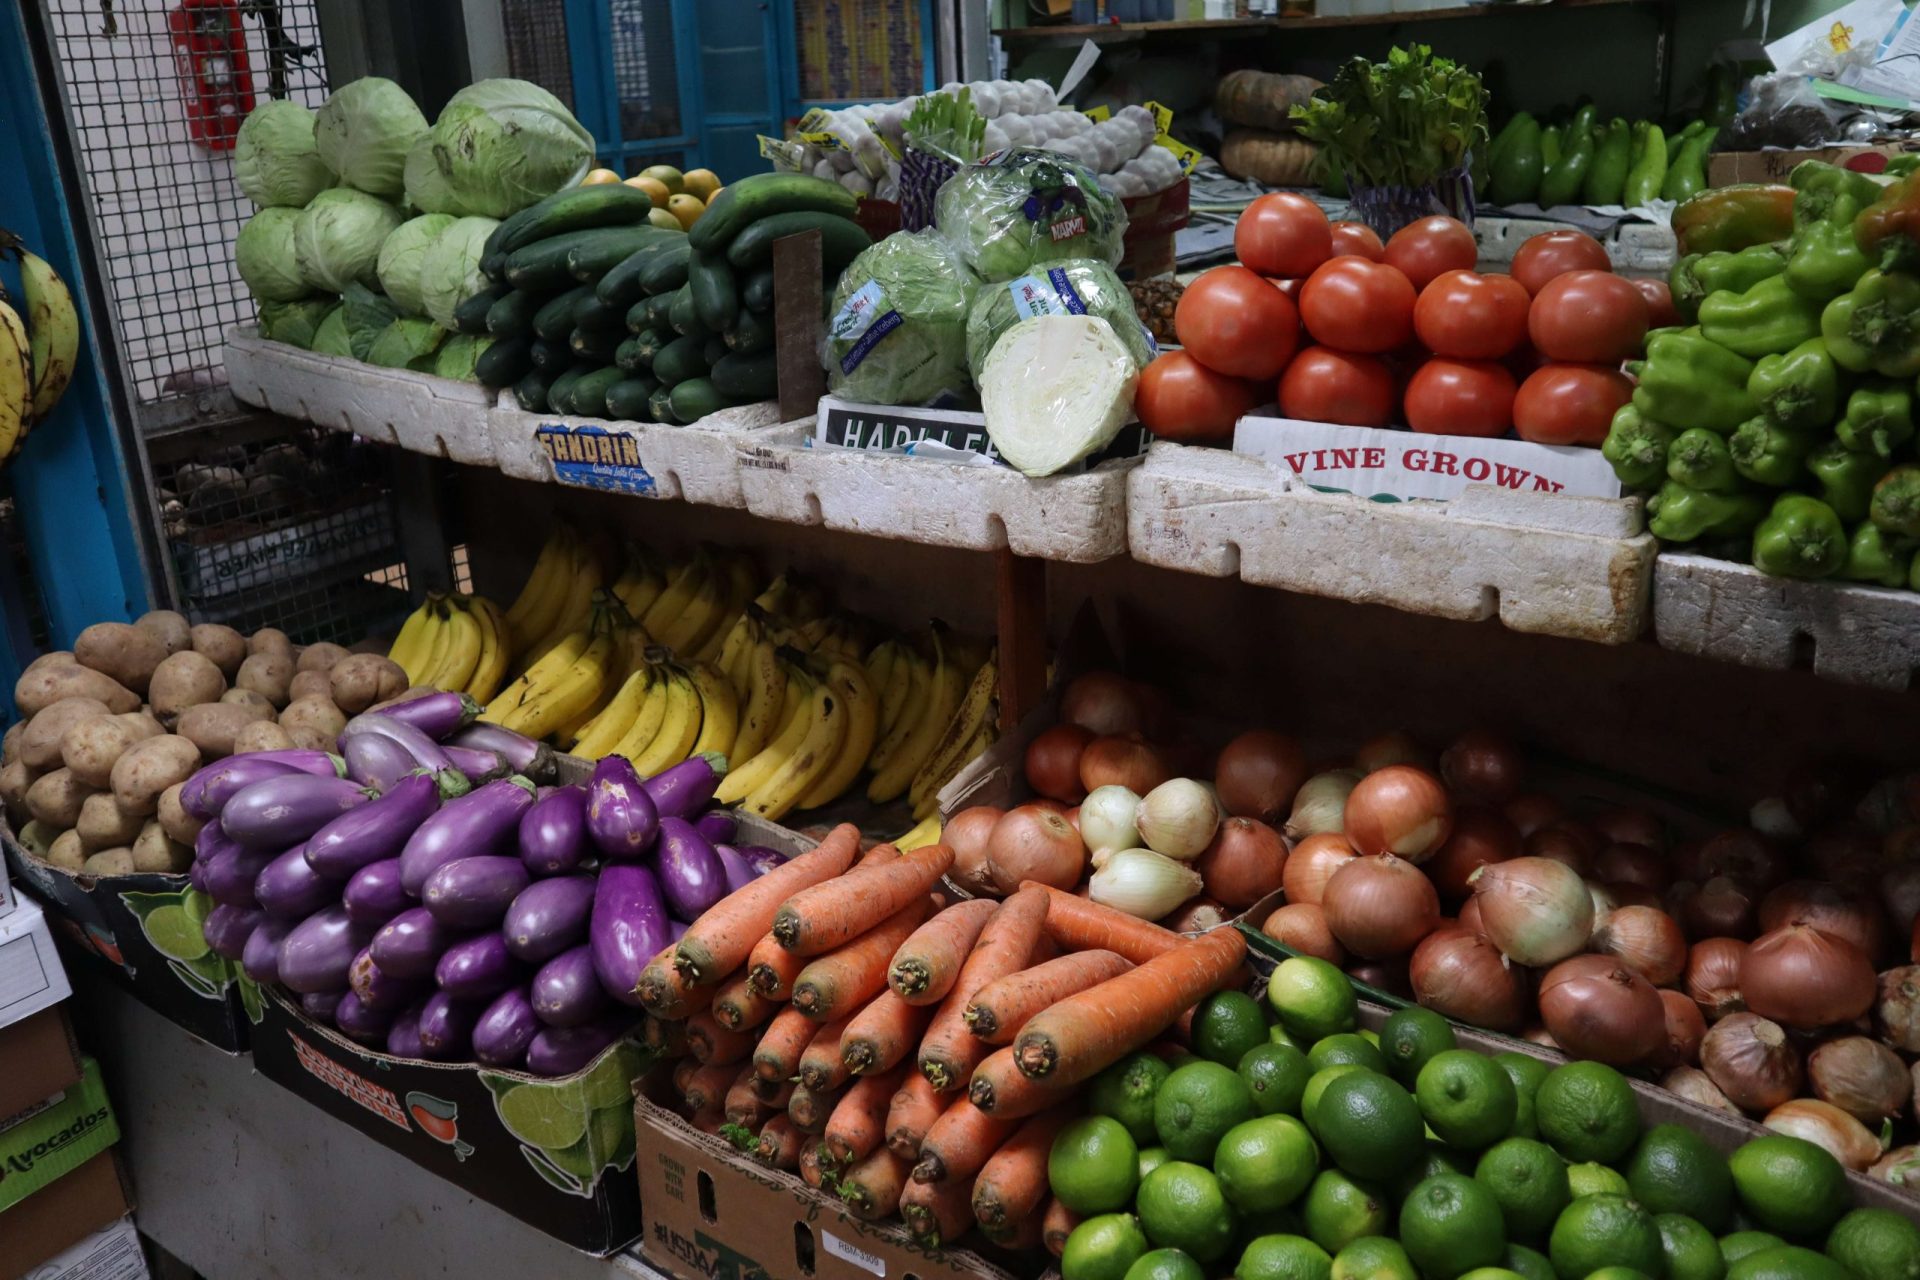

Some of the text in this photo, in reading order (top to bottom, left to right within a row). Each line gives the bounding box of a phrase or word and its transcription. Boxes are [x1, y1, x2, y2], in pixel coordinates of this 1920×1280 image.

[1284, 447, 1565, 493] VINE GROWN
[6, 1105, 109, 1174] Avocados
